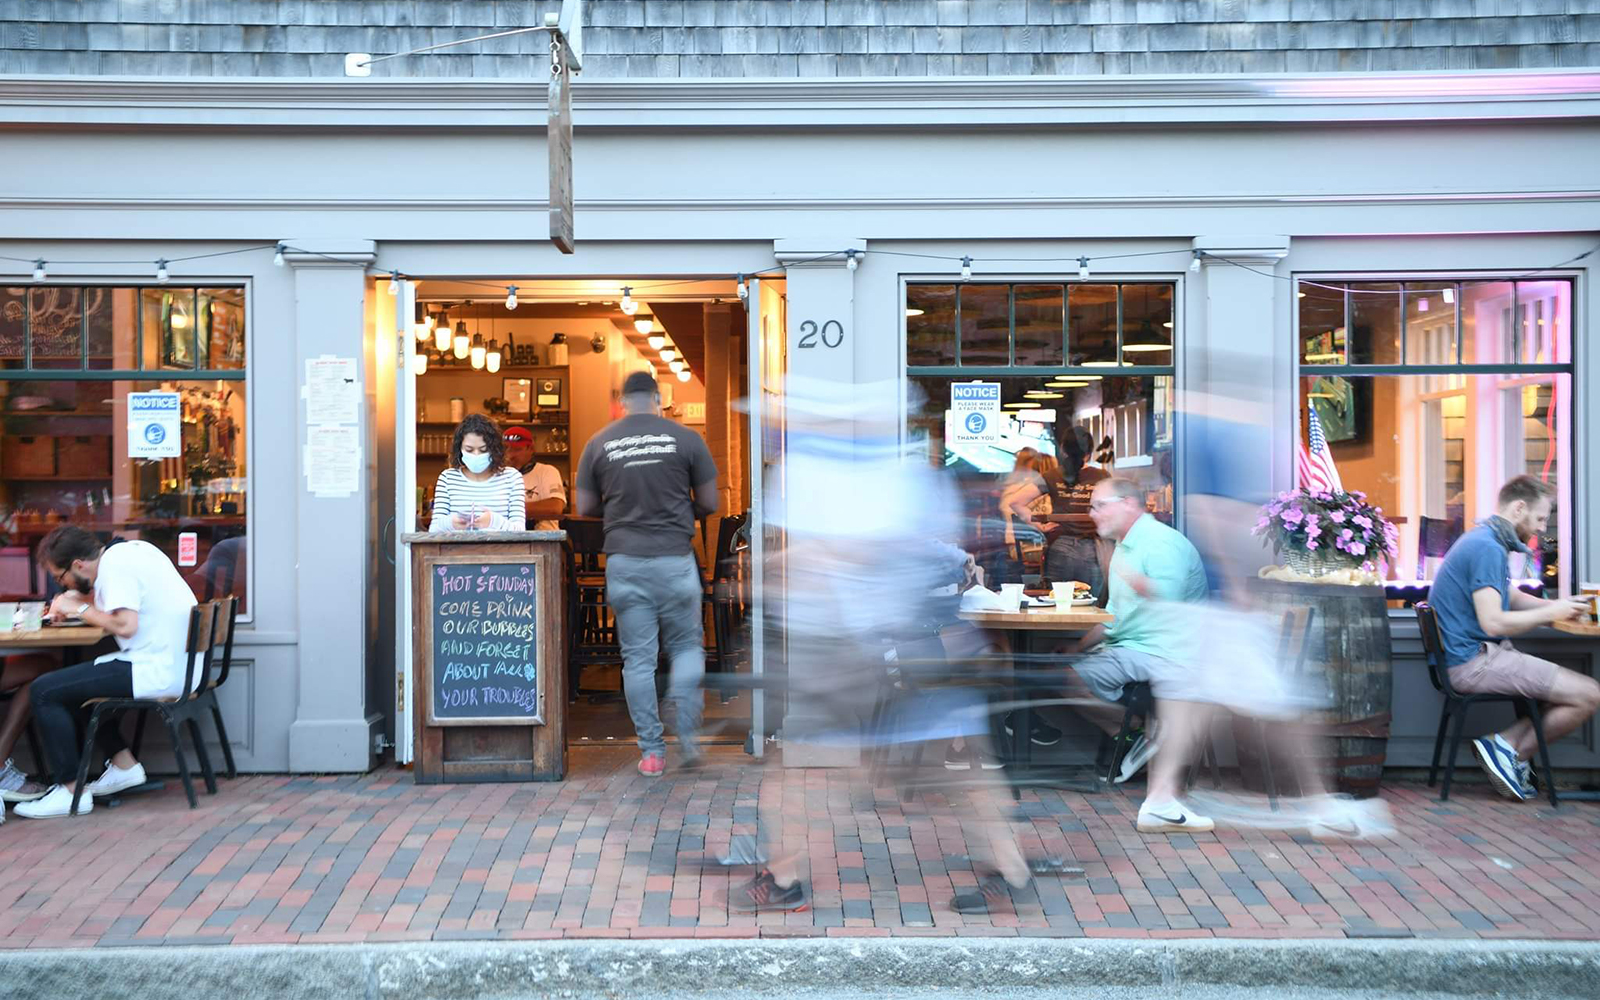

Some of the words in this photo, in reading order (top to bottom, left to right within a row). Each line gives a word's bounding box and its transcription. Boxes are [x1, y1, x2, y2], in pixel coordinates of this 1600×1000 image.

[798, 319, 844, 348] 20
[132, 397, 177, 408] NOTICE
[955, 387, 998, 398] NOTICE
[1072, 491, 1091, 499] Good
[442, 575, 473, 595] HOT
[439, 601, 483, 617] COME
[487, 598, 532, 618] DRINK
[442, 619, 479, 635] OUR
[481, 620, 534, 641] BUBBLES
[441, 640, 474, 656] AND
[476, 640, 531, 661] FORGET
[442, 662, 490, 684] ABOUT
[494, 661, 523, 678] ALL
[441, 688, 479, 708] YOUR
[481, 686, 535, 710] TROUBLES
